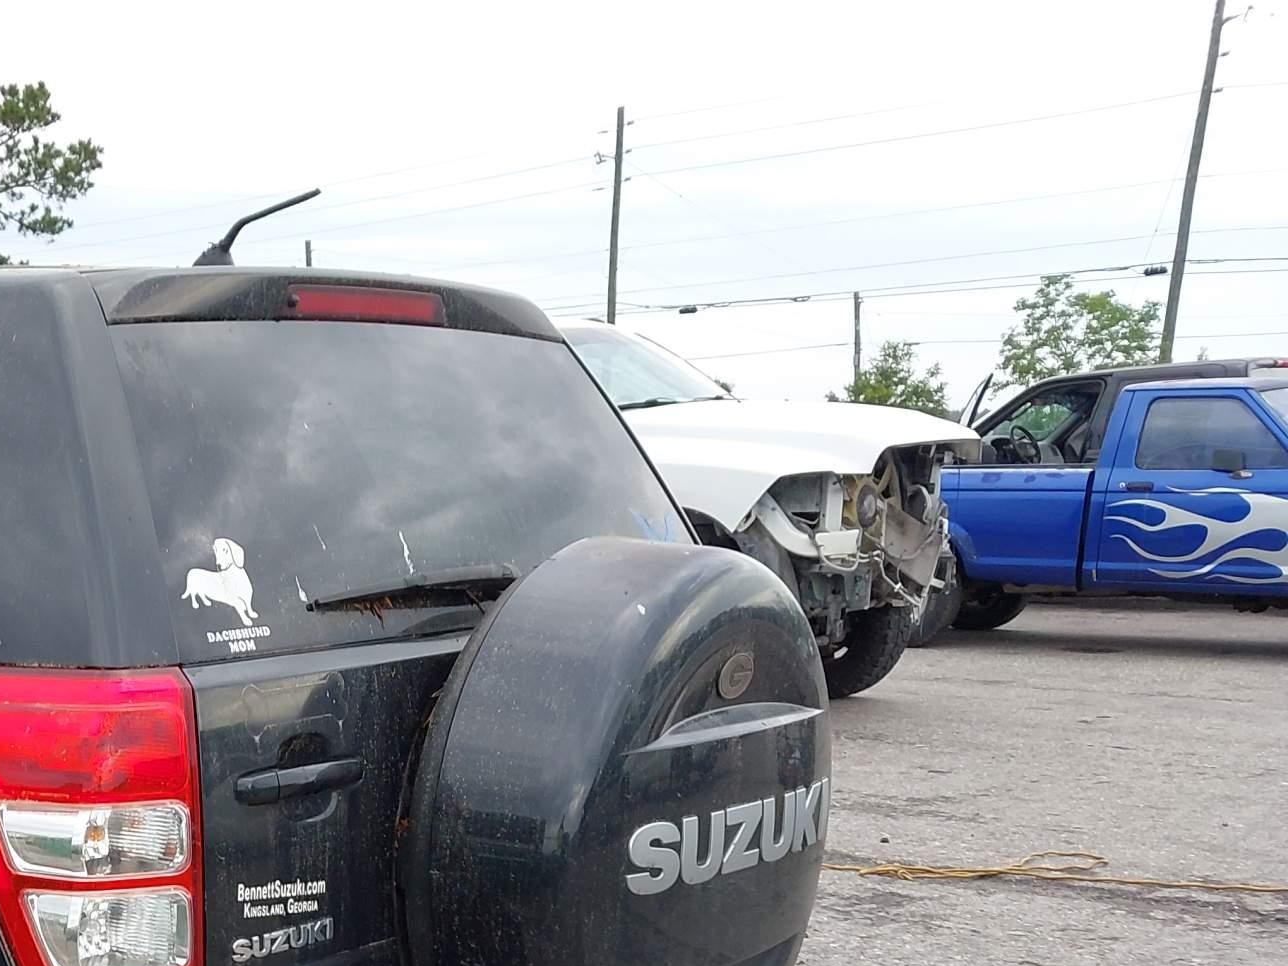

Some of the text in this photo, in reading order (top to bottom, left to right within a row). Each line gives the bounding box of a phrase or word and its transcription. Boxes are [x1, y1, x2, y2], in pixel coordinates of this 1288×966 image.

[207, 626, 271, 643] DACHSHUND
[228, 639, 257, 653] MOM
[625, 776, 829, 896] SUZUKI
[237, 878, 326, 902] BennettSuzuki.com
[232, 917, 334, 963] SUZUKI
